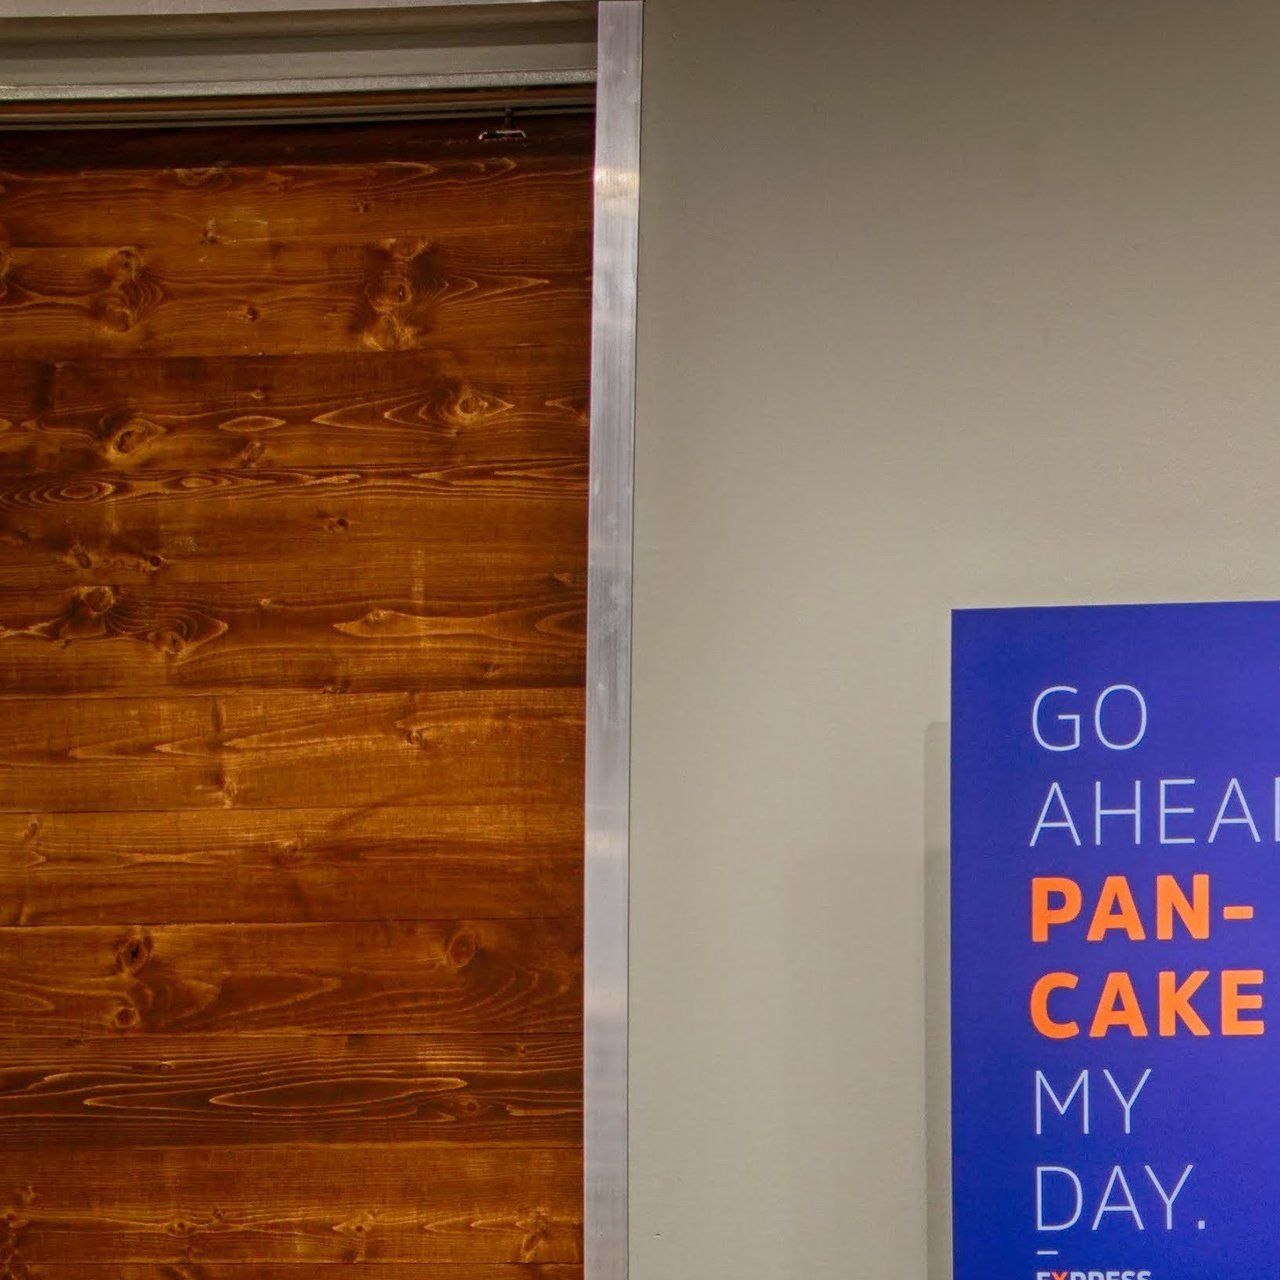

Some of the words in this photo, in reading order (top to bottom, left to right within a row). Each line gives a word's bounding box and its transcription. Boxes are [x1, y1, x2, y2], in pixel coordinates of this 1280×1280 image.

[1031, 684, 1147, 752] GO
[1030, 873, 1254, 942] PAN-
[1030, 969, 1265, 1039] CAKE
[1035, 1068, 1152, 1135] MY
[1035, 1164, 1206, 1231] DAY.
